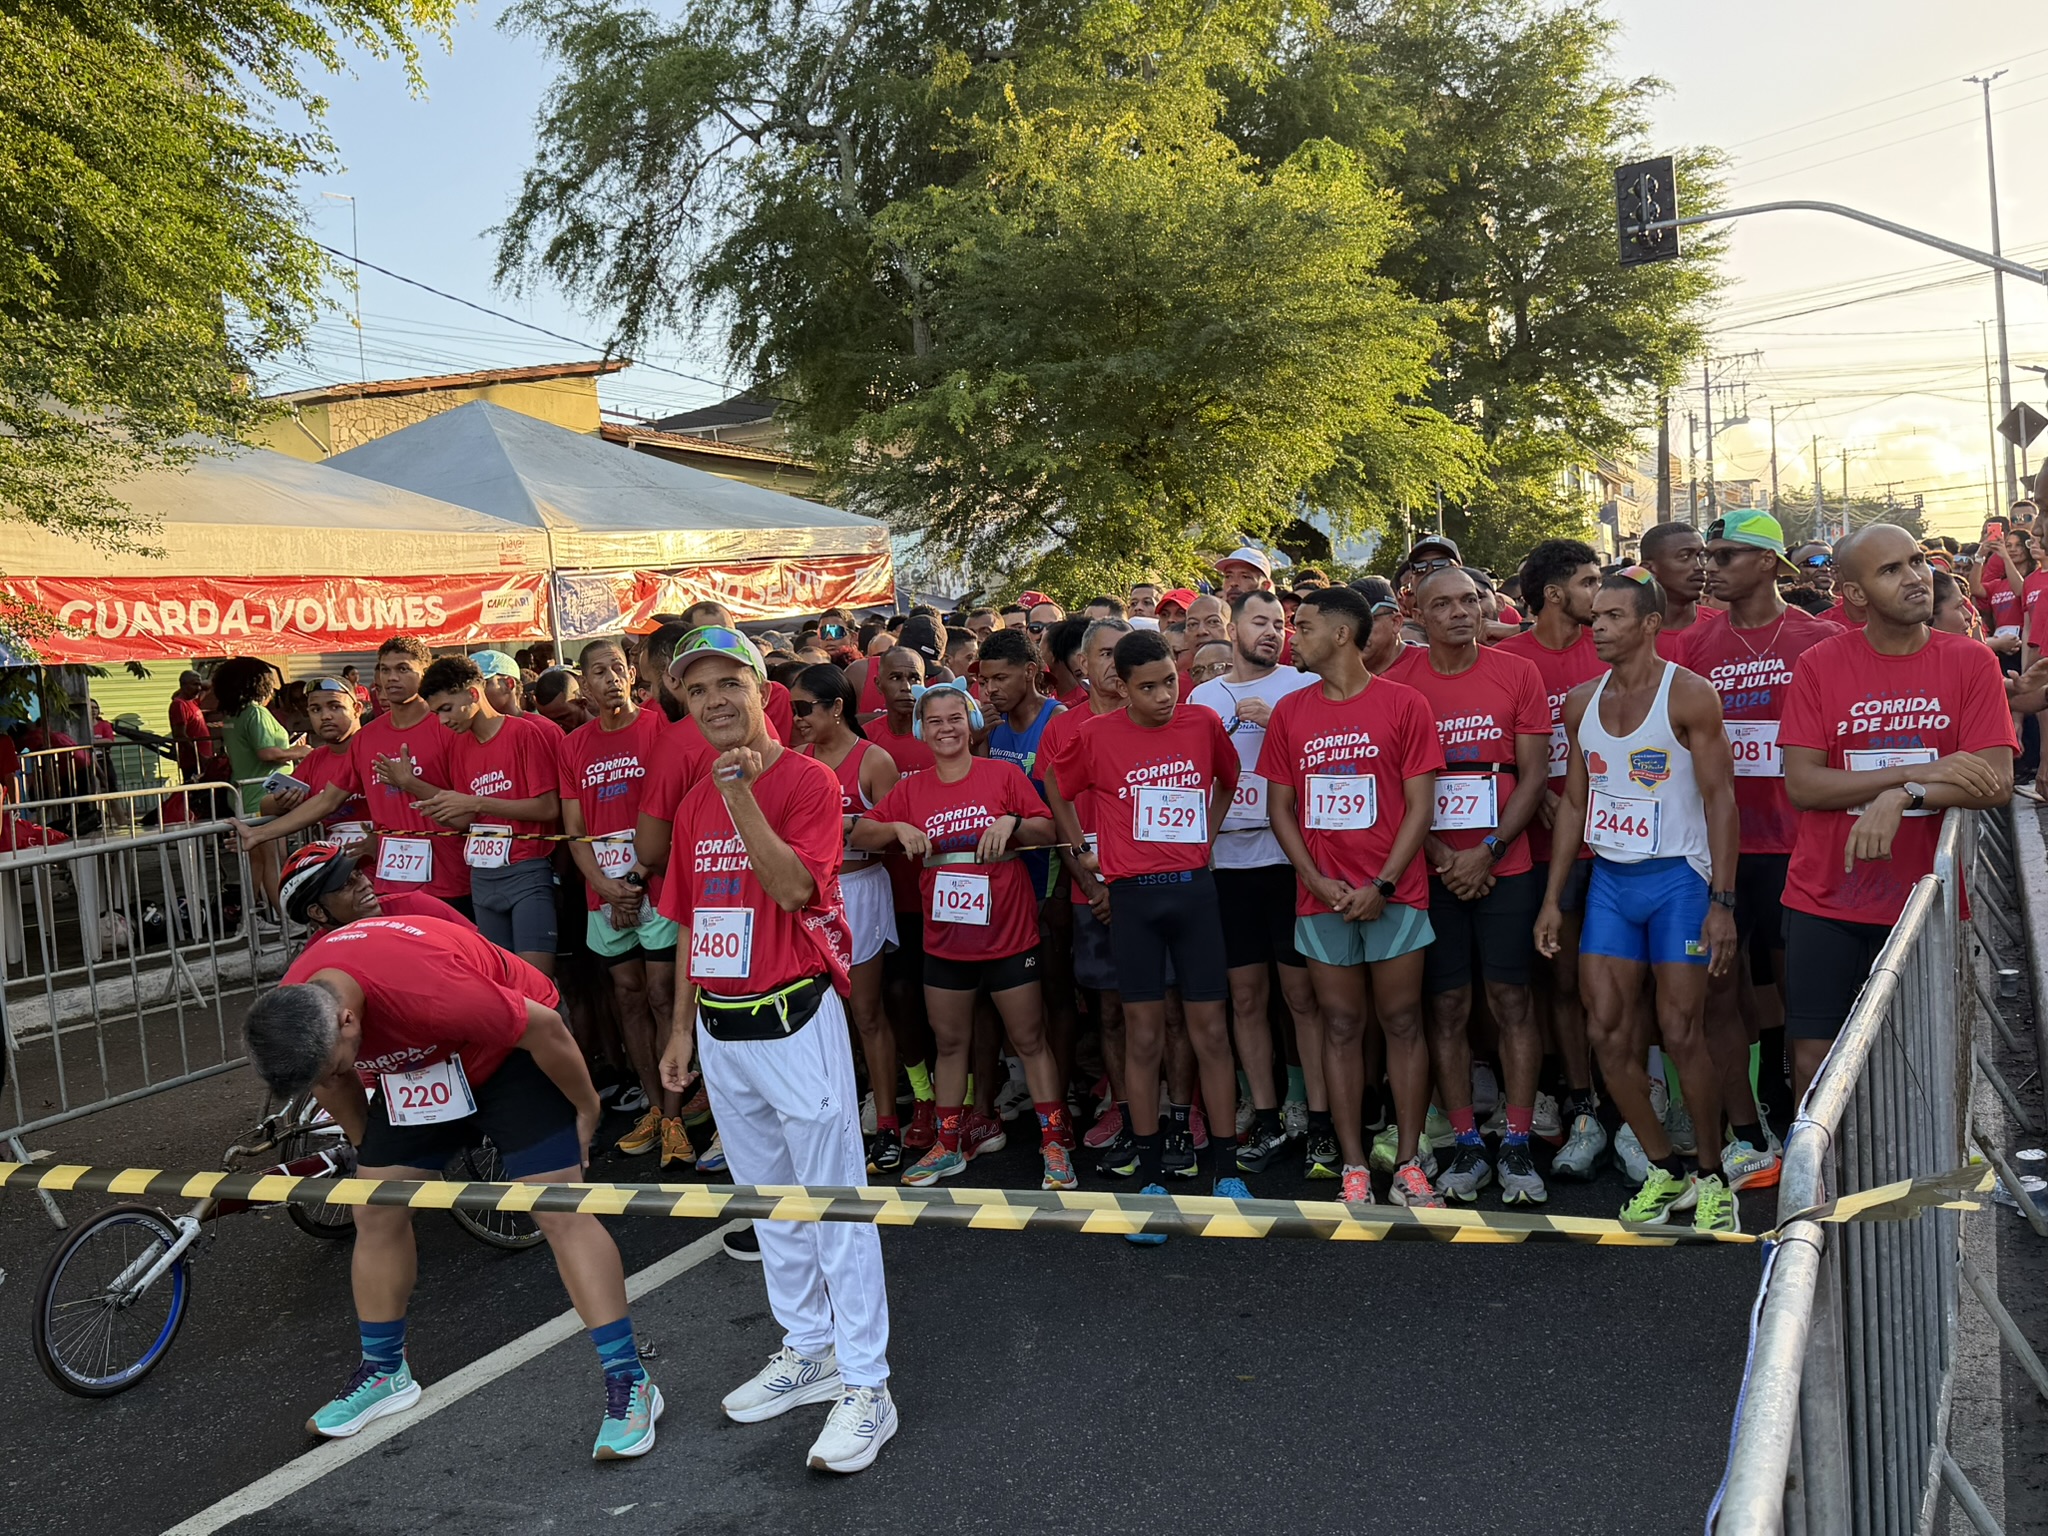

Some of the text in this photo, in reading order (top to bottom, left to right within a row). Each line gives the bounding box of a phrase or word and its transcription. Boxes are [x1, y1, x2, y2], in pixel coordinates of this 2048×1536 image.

[58, 596, 448, 641] GUARDA-VOLUMES
[1709, 659, 1785, 679] CORRIDA
[1712, 672, 1793, 691] DE JULHO
[1724, 689, 1771, 710] 2026
[1849, 697, 1941, 717] CORRIDA
[1436, 714, 1494, 732] ORRIDA
[1837, 715, 1950, 736] 2 DE JULHO
[1304, 732, 1371, 754] CORRIDA
[1446, 728, 1502, 744] JULHO
[1299, 746, 1380, 771] 2 DE JULHO
[1732, 740, 1773, 761] 081
[586, 756, 639, 775] CORRIDA
[1125, 760, 1194, 783] CORRIDA
[581, 767, 646, 790] 2 DE JULHO
[1118, 787, 1128, 800] 2
[1232, 786, 1259, 806] 30
[1316, 794, 1366, 815] 1739
[1437, 795, 1479, 815] 927
[924, 805, 988, 828] CORRIDA
[1144, 806, 1197, 828] 1529
[1594, 809, 1649, 838] 2446
[927, 816, 996, 840] DE JULHO
[471, 839, 504, 856] 2083
[597, 847, 632, 868] 2026
[385, 853, 425, 871] 2377
[695, 857, 711, 873] DE
[937, 889, 985, 911] 1024
[692, 932, 740, 958] 2480
[353, 1046, 422, 1070] ORRIDA
[398, 1081, 451, 1109] 220
